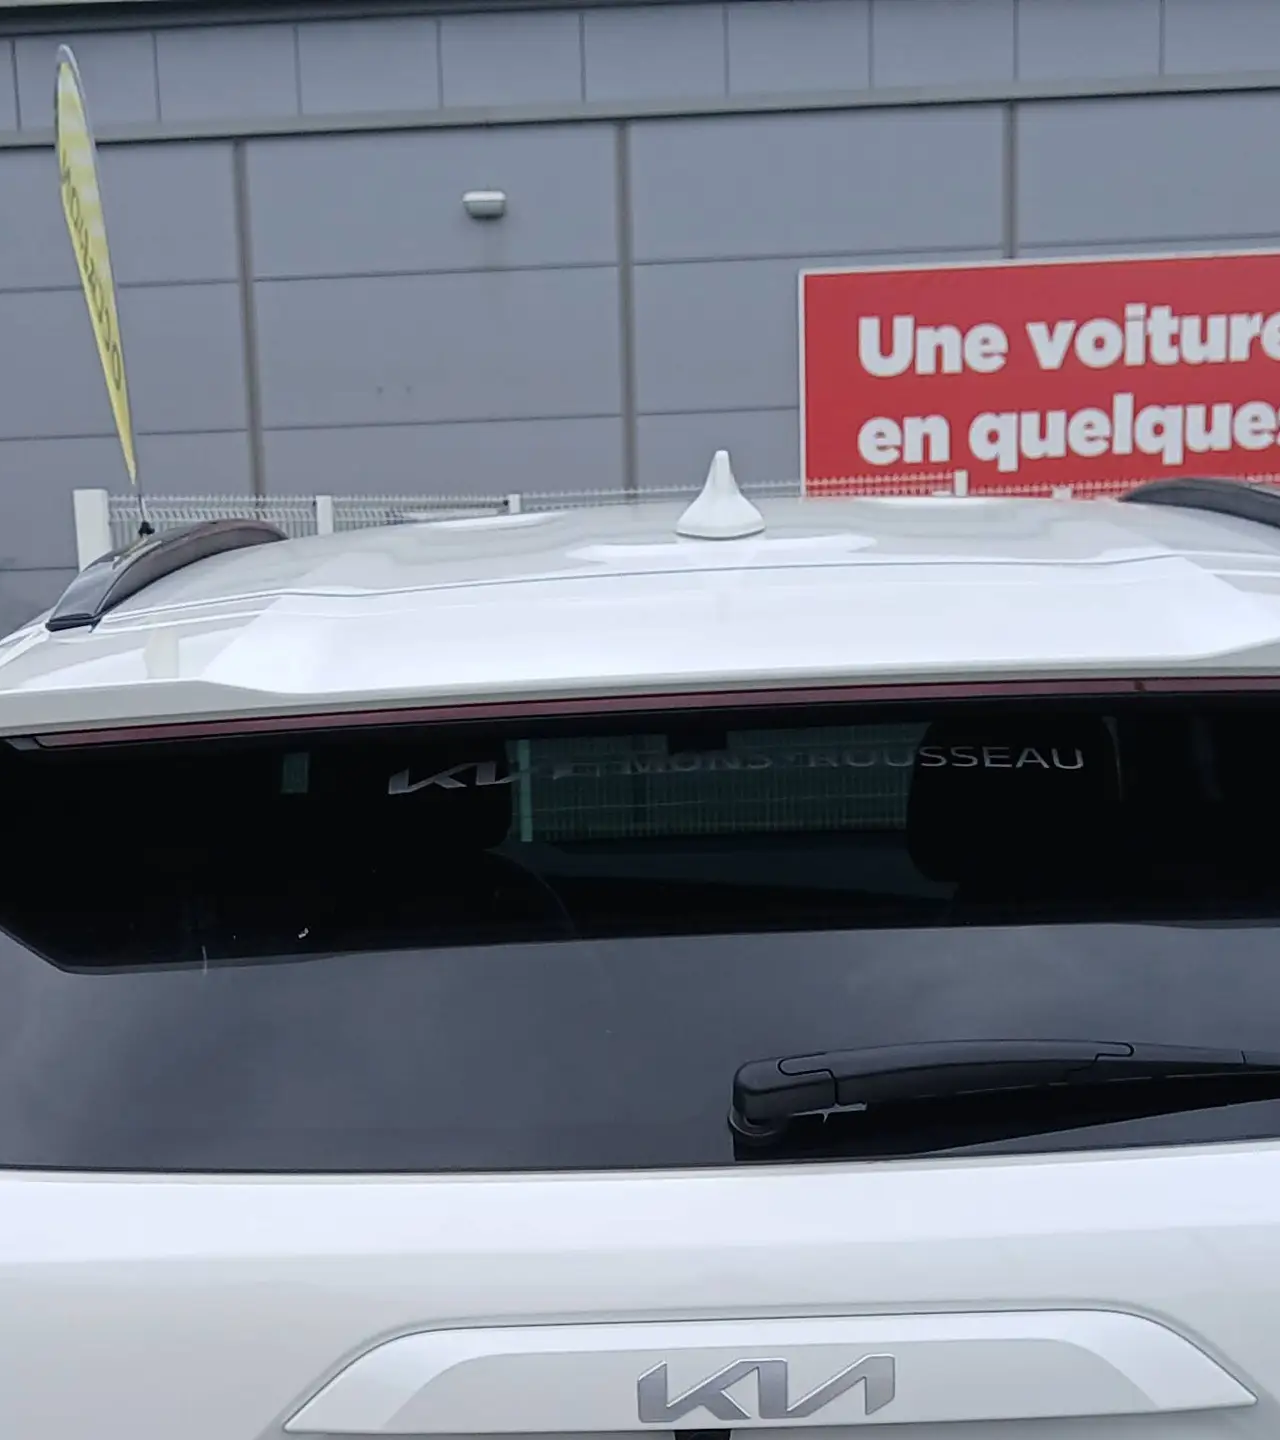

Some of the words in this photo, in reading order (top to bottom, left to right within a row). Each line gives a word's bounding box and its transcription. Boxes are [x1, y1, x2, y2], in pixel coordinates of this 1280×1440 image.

[858, 313, 1007, 376] Une
[858, 414, 951, 465] en
[807, 746, 1085, 772] ROUSSEAU
[637, 1353, 896, 1424] KIA
